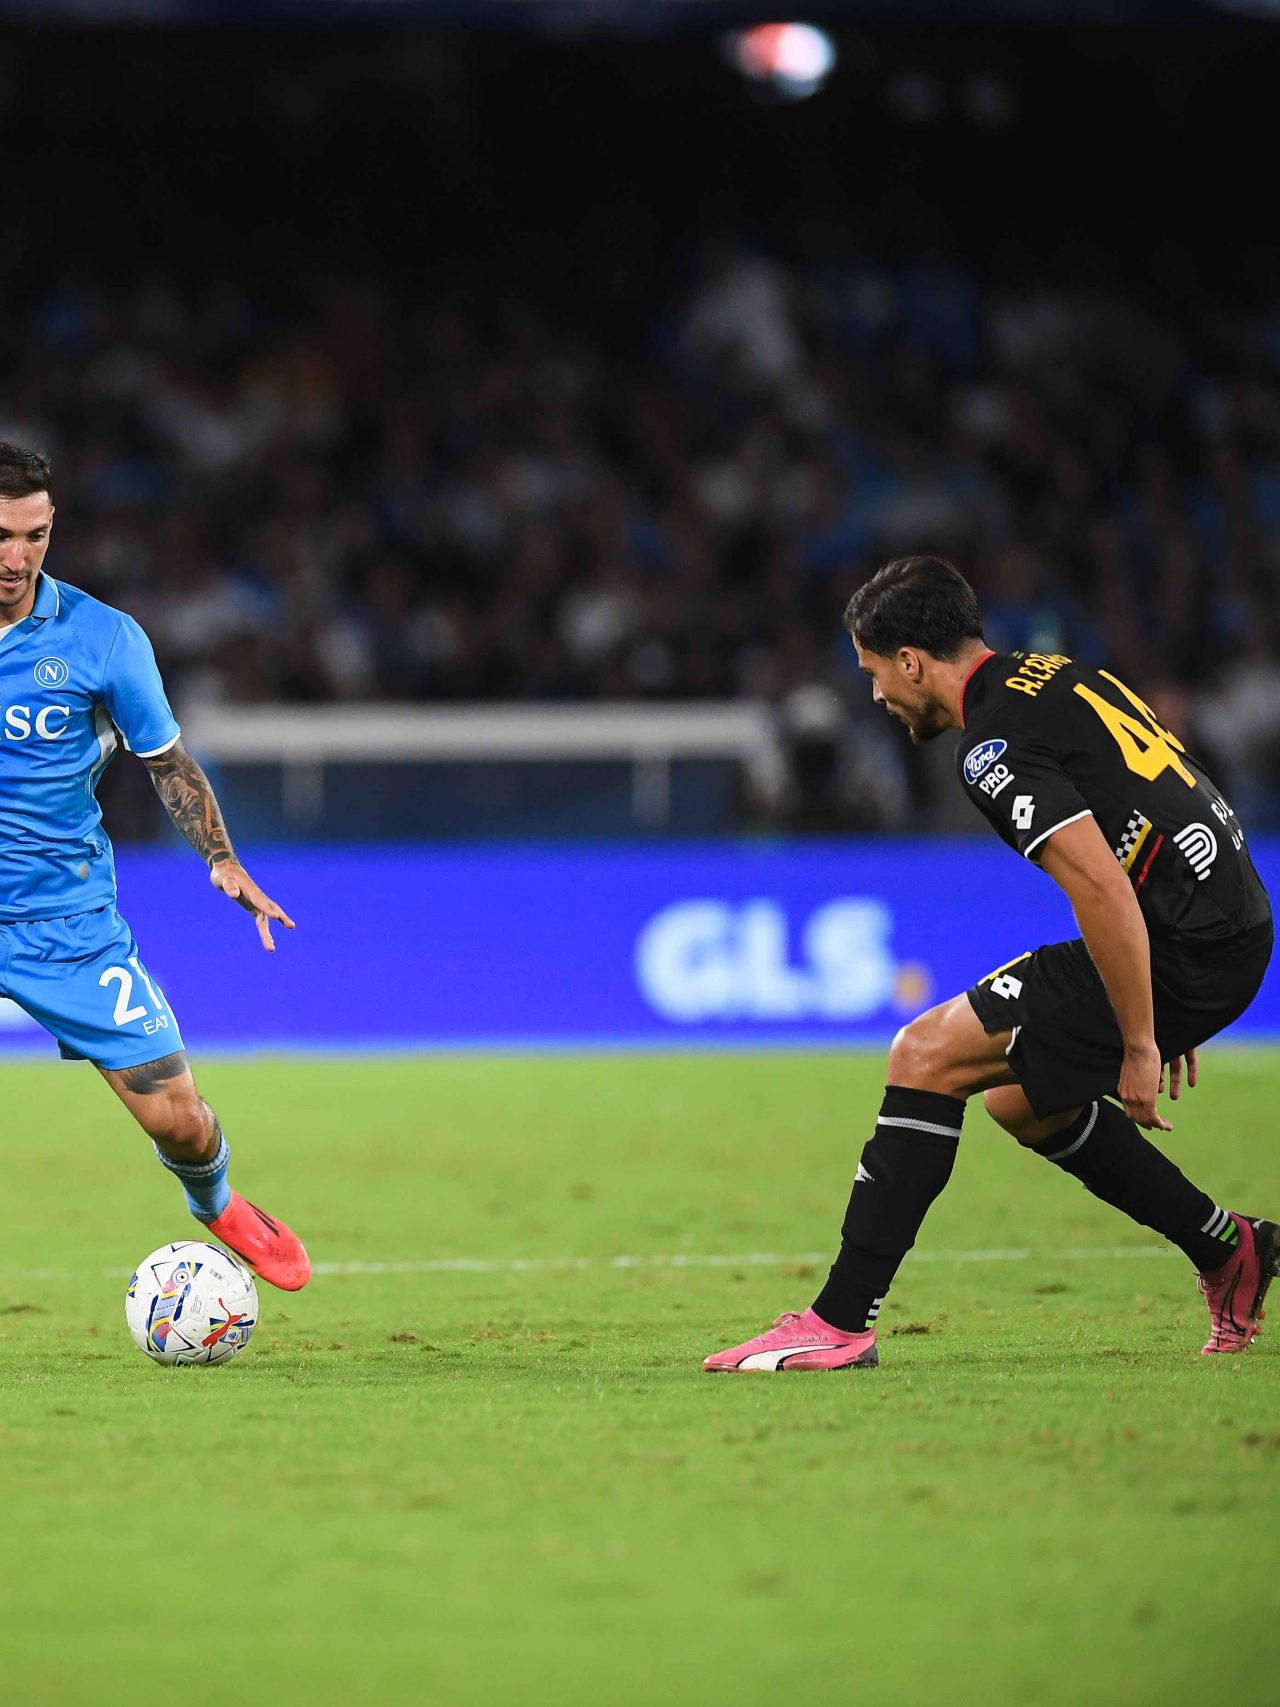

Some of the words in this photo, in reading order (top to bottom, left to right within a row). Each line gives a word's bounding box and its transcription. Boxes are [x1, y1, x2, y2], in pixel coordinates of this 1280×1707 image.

[966, 744, 996, 778] Ford
[978, 763, 1009, 795] PRO
[99, 956, 163, 1026] 21
[142, 1015, 168, 1035] EA7
